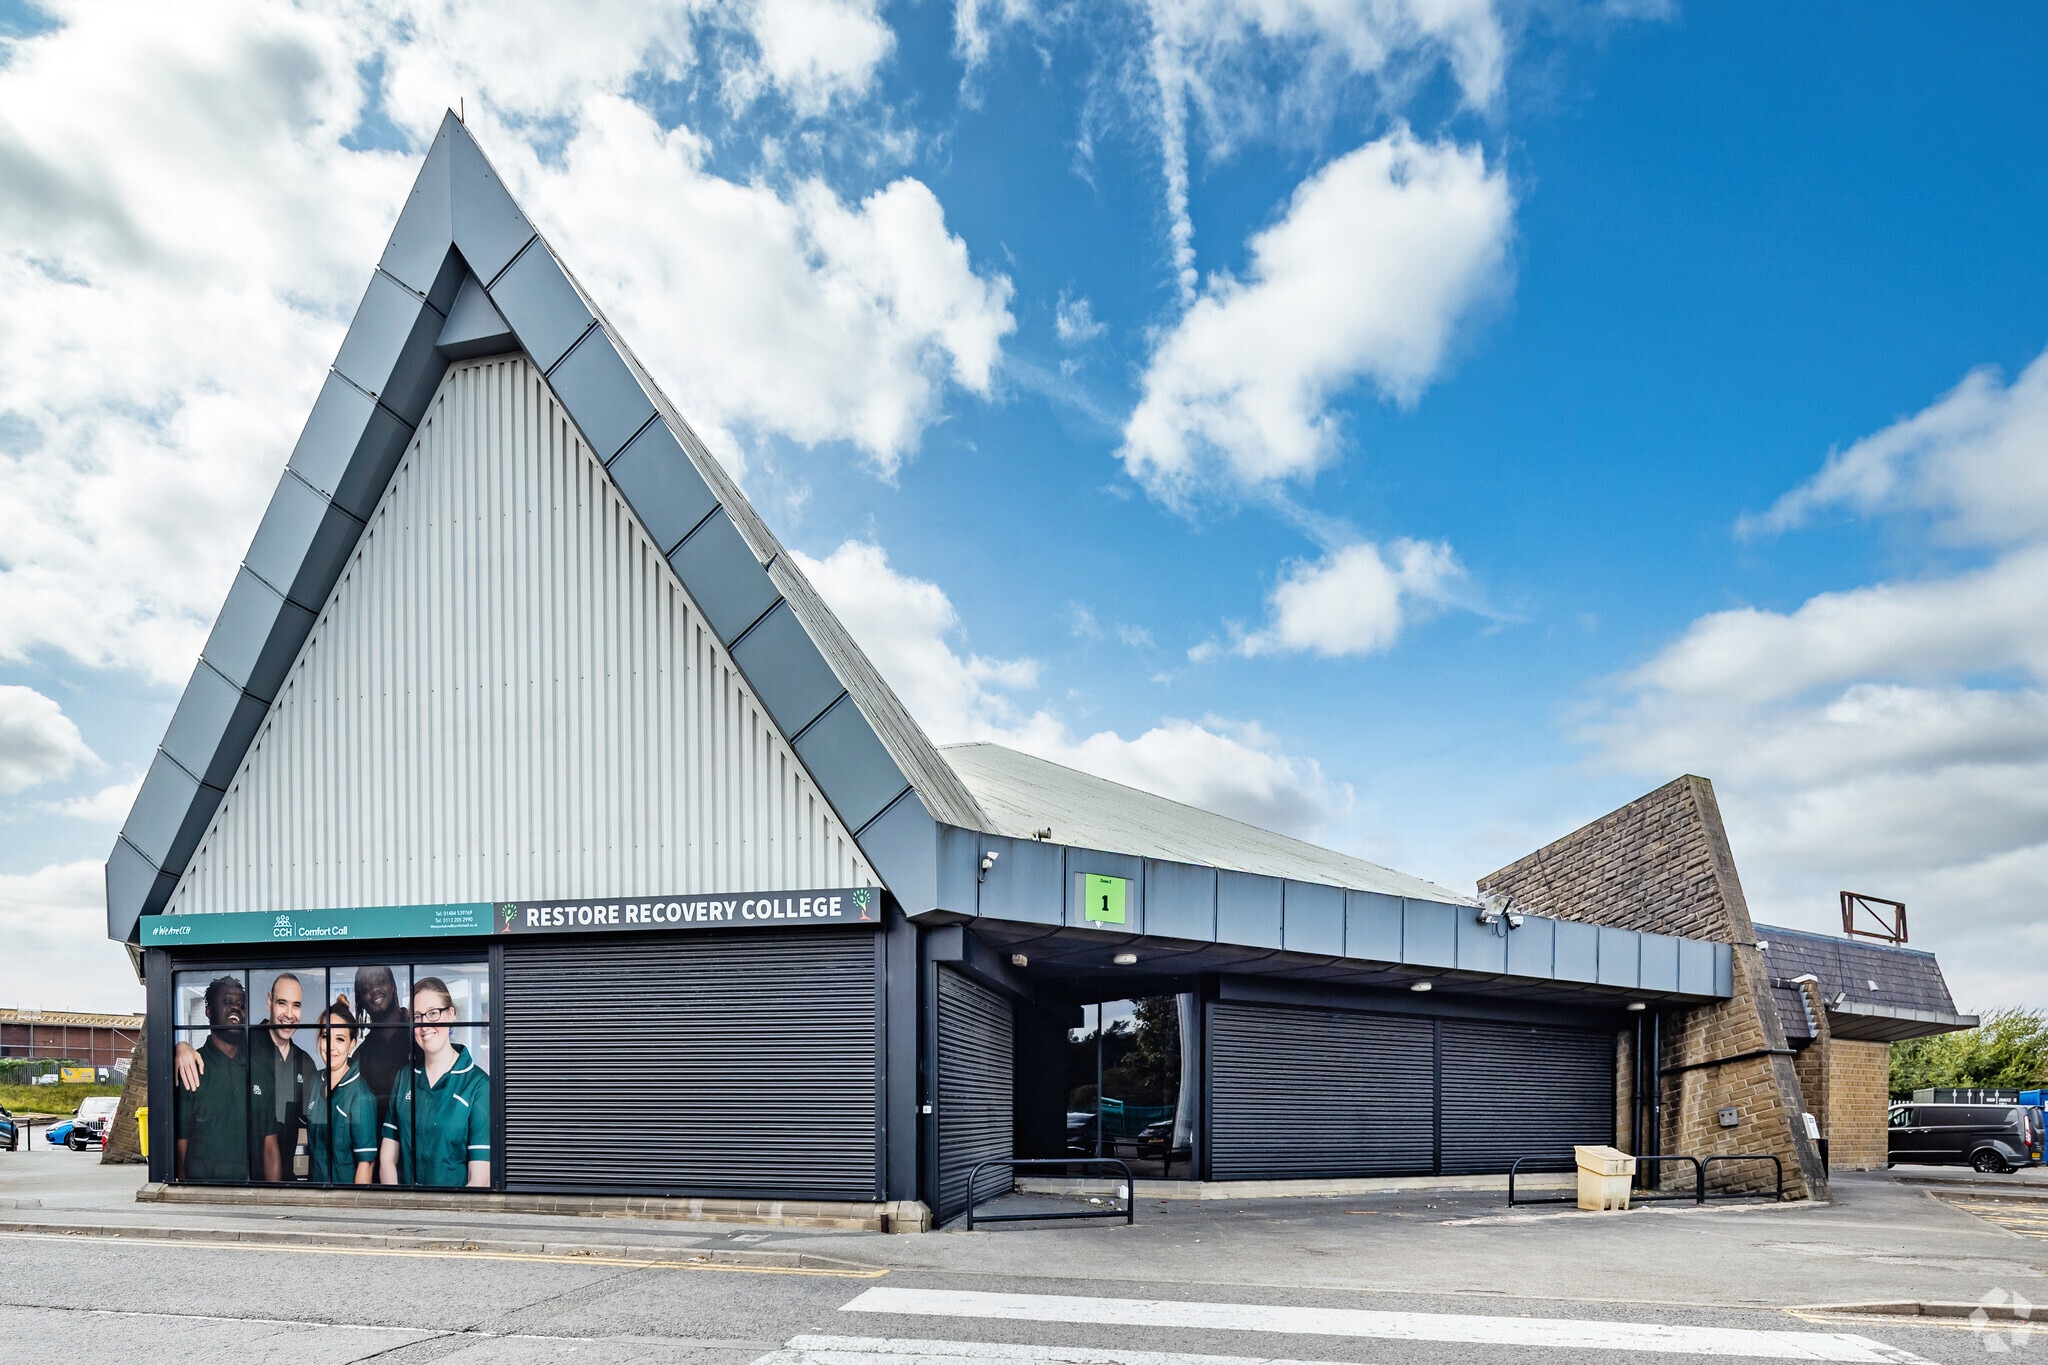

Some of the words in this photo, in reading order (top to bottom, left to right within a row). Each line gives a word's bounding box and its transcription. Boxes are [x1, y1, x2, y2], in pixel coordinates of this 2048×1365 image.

[1101, 895, 1109, 911] 1
[526, 905, 620, 927] RESTORE
[625, 900, 738, 924] RECOVERY
[741, 896, 842, 920] COLLEGE
[273, 928, 292, 937] CCH
[298, 927, 331, 937] Comfort
[331, 925, 348, 935] Call
